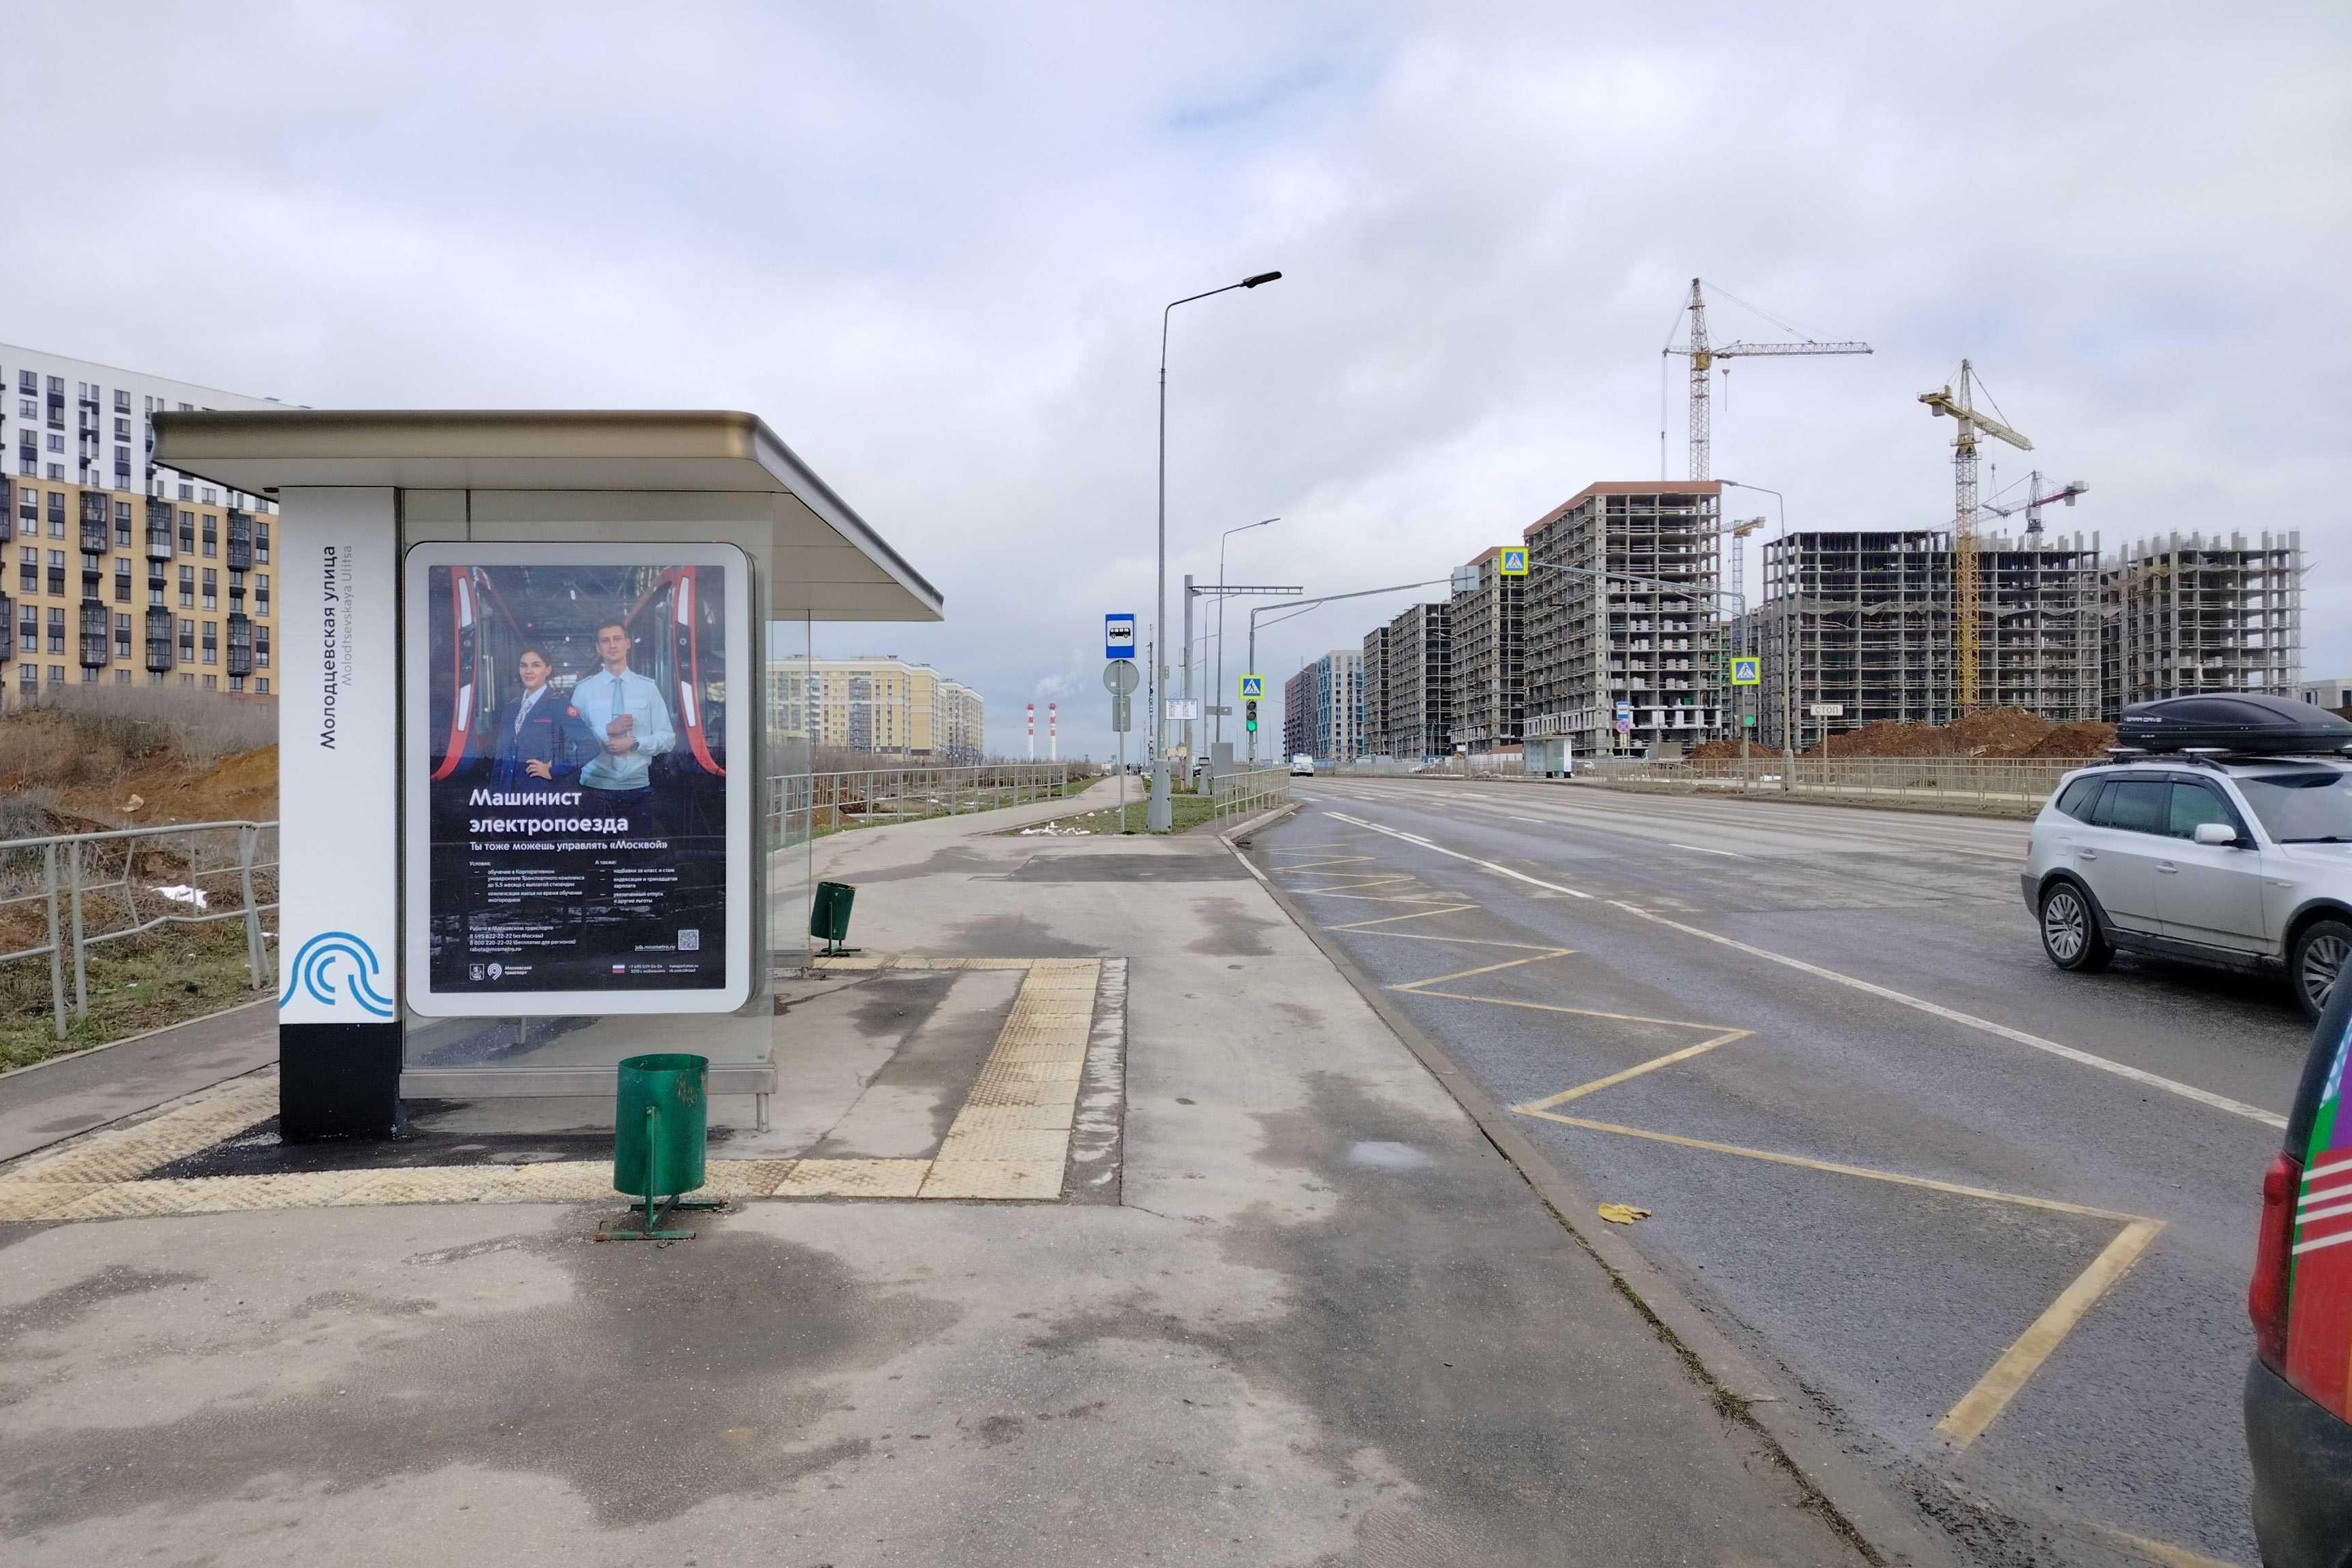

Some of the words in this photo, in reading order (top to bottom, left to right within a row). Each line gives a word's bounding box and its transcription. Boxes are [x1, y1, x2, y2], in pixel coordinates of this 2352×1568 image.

[324, 546, 339, 602] улица
[341, 546, 352, 582] Ulitsa
[341, 585, 355, 686] Molodtsevskaya
[320, 606, 338, 750] Молодцевская
[1815, 706, 1838, 714] СТОП
[469, 789, 582, 806] Машинист
[469, 818, 629, 836] электропоезда
[470, 842, 483, 851] Ты
[485, 843, 510, 851] тоже
[512, 842, 555, 851] можешь
[557, 842, 607, 851] управлять
[610, 840, 668, 849] «Москвой»
